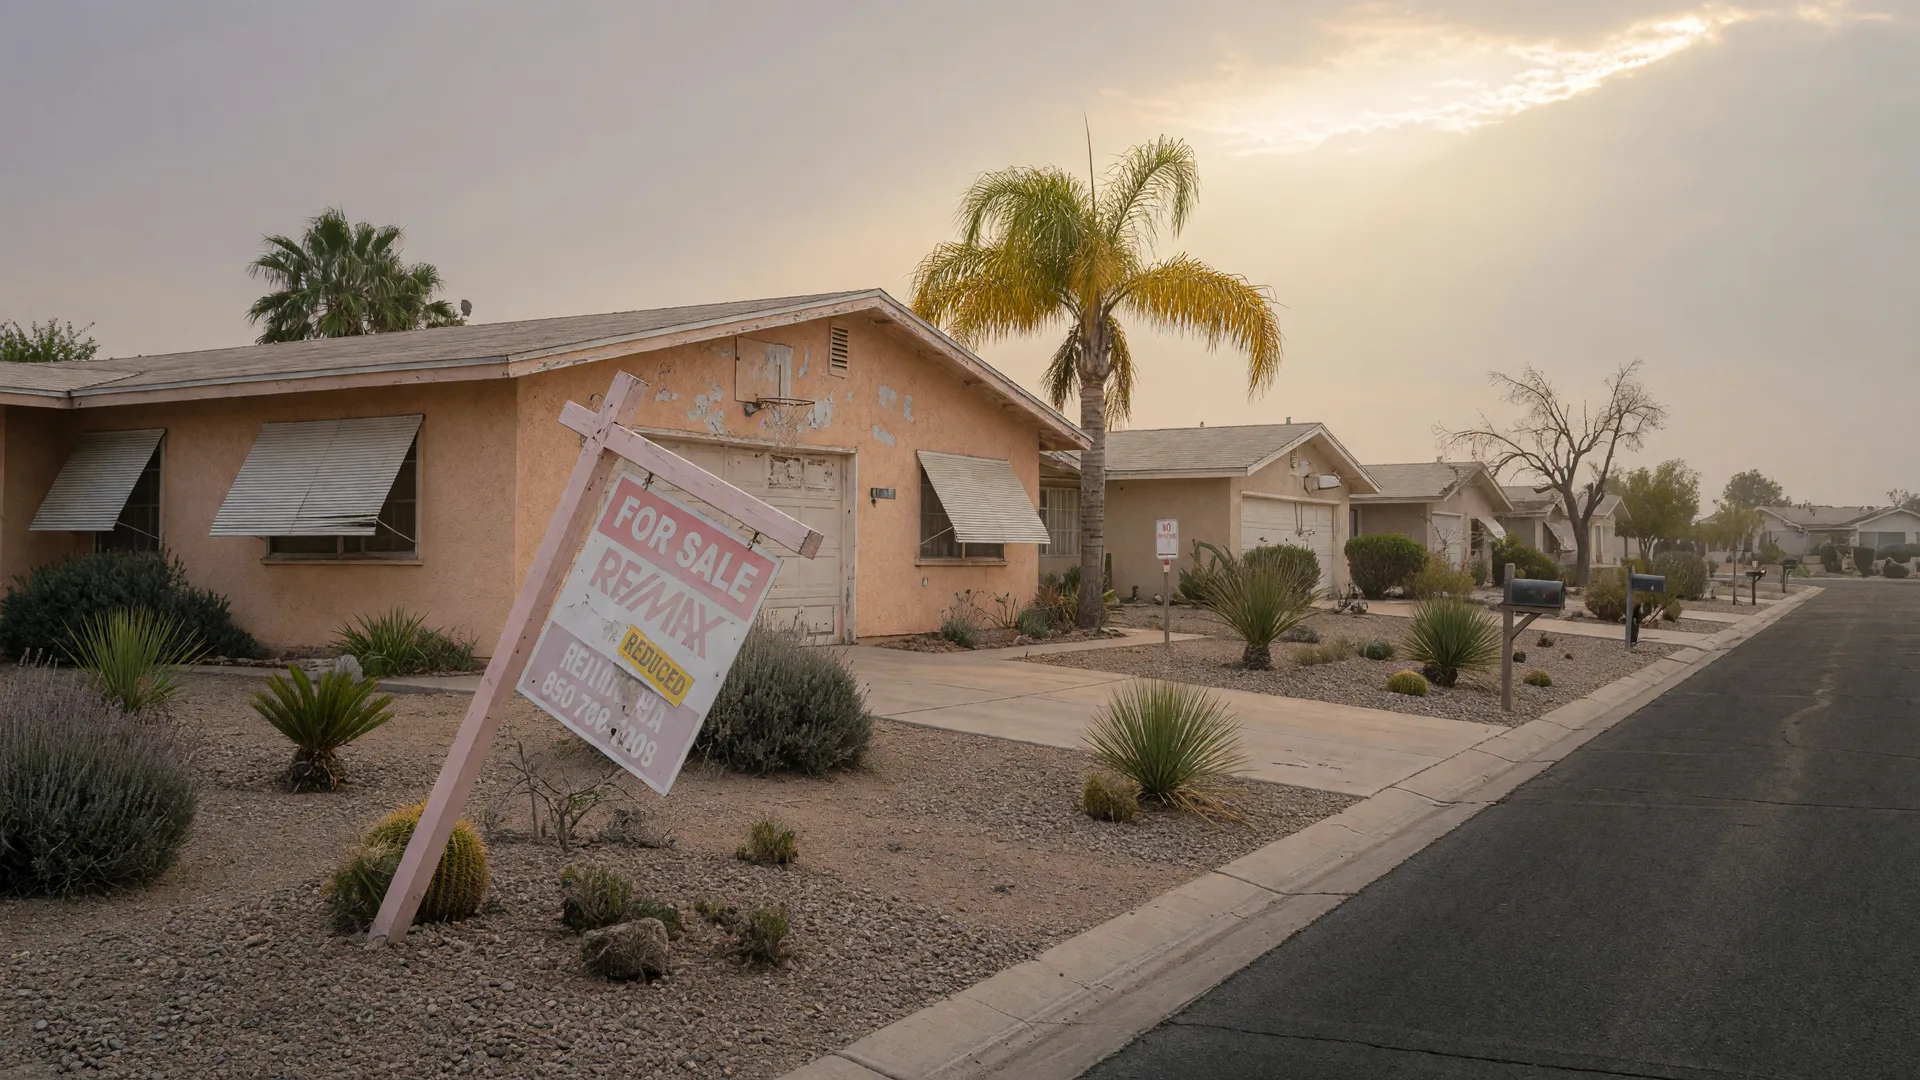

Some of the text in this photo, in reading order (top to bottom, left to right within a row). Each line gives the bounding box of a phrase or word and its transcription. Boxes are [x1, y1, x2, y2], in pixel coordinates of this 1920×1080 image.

[613, 495, 759, 603] FOR SALE
[588, 547, 727, 660] RE/MAX
[541, 671, 576, 709] 850
[623, 632, 686, 696] REDUCED
